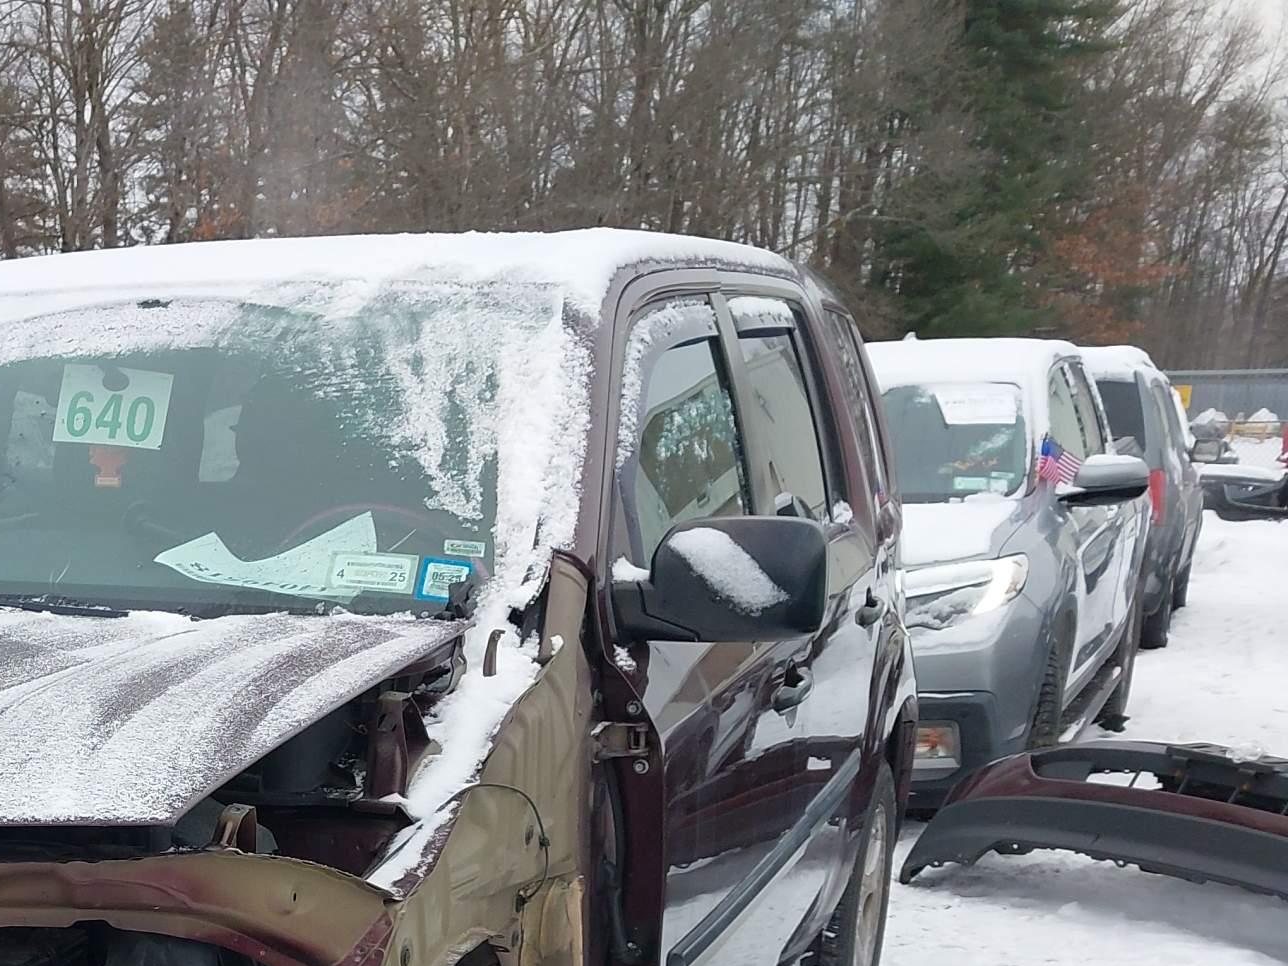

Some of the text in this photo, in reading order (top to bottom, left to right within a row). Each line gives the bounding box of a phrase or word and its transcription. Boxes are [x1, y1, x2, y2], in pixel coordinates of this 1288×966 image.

[66, 390, 155, 442] 640
[337, 569, 405, 582] 4 25
